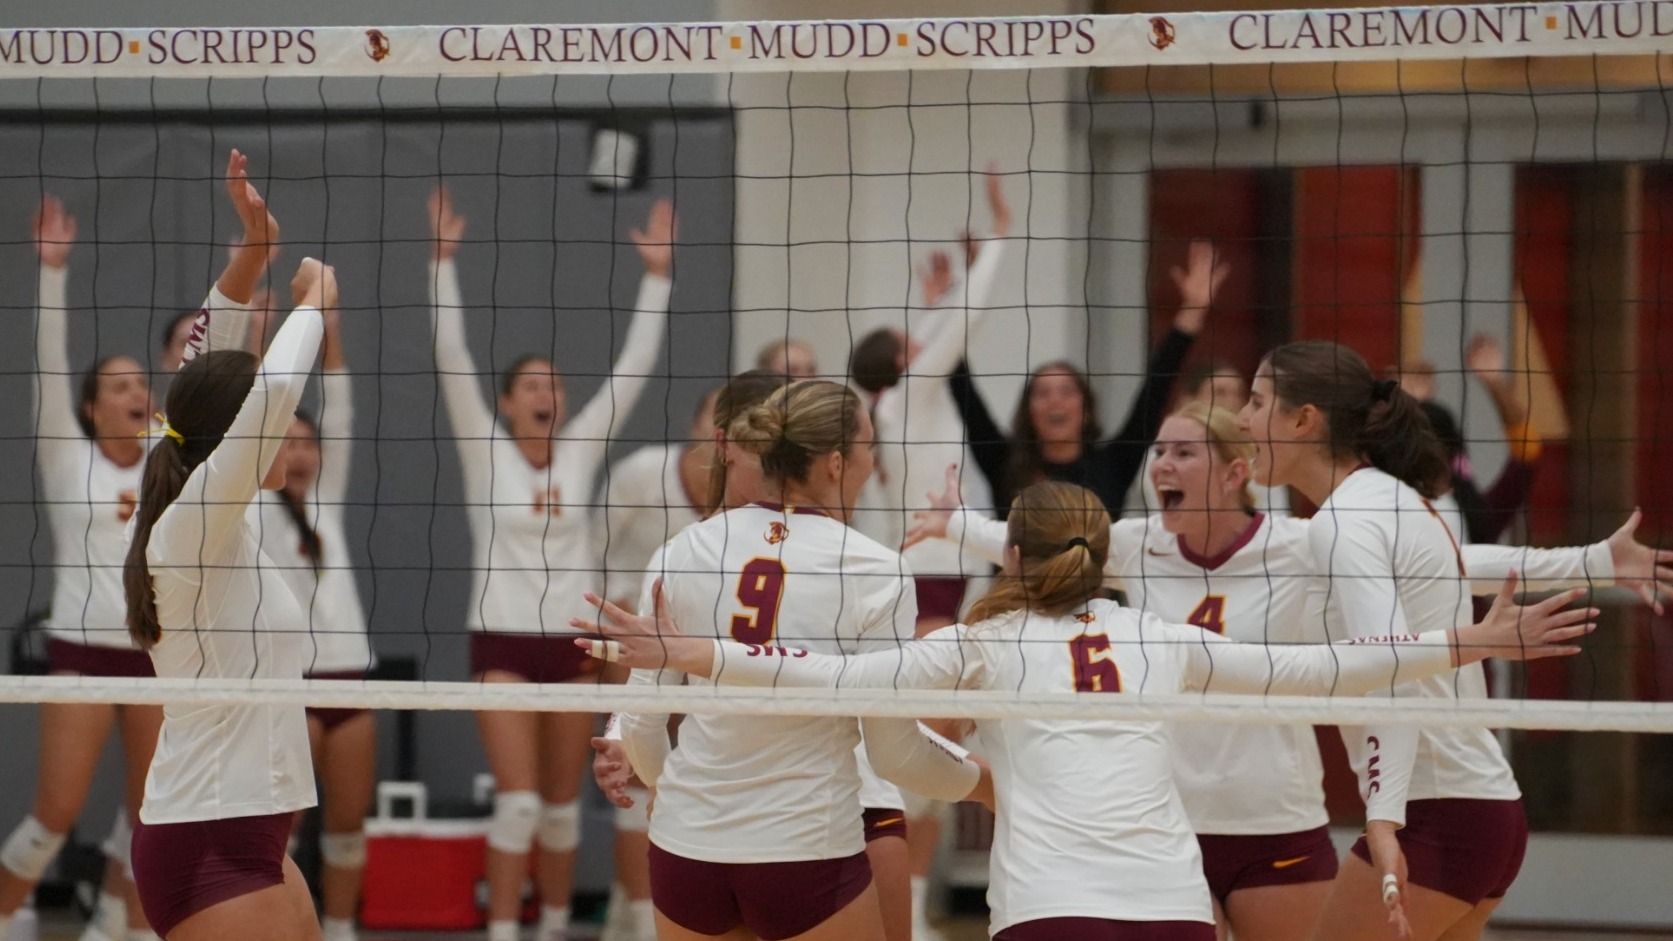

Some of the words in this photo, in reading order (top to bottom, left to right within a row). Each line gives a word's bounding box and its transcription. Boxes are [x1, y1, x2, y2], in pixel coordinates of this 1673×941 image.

[0, 30, 124, 65] MUDD
[147, 29, 317, 64] SCRIPPS
[438, 26, 723, 62] CLAREMONT
[747, 23, 890, 59] MUDD
[916, 17, 1096, 57] SCRIPPS
[1229, 5, 1537, 50] CLAREMONT
[730, 556, 787, 646] 9
[1187, 595, 1226, 636] 4
[1068, 631, 1123, 694] 6
